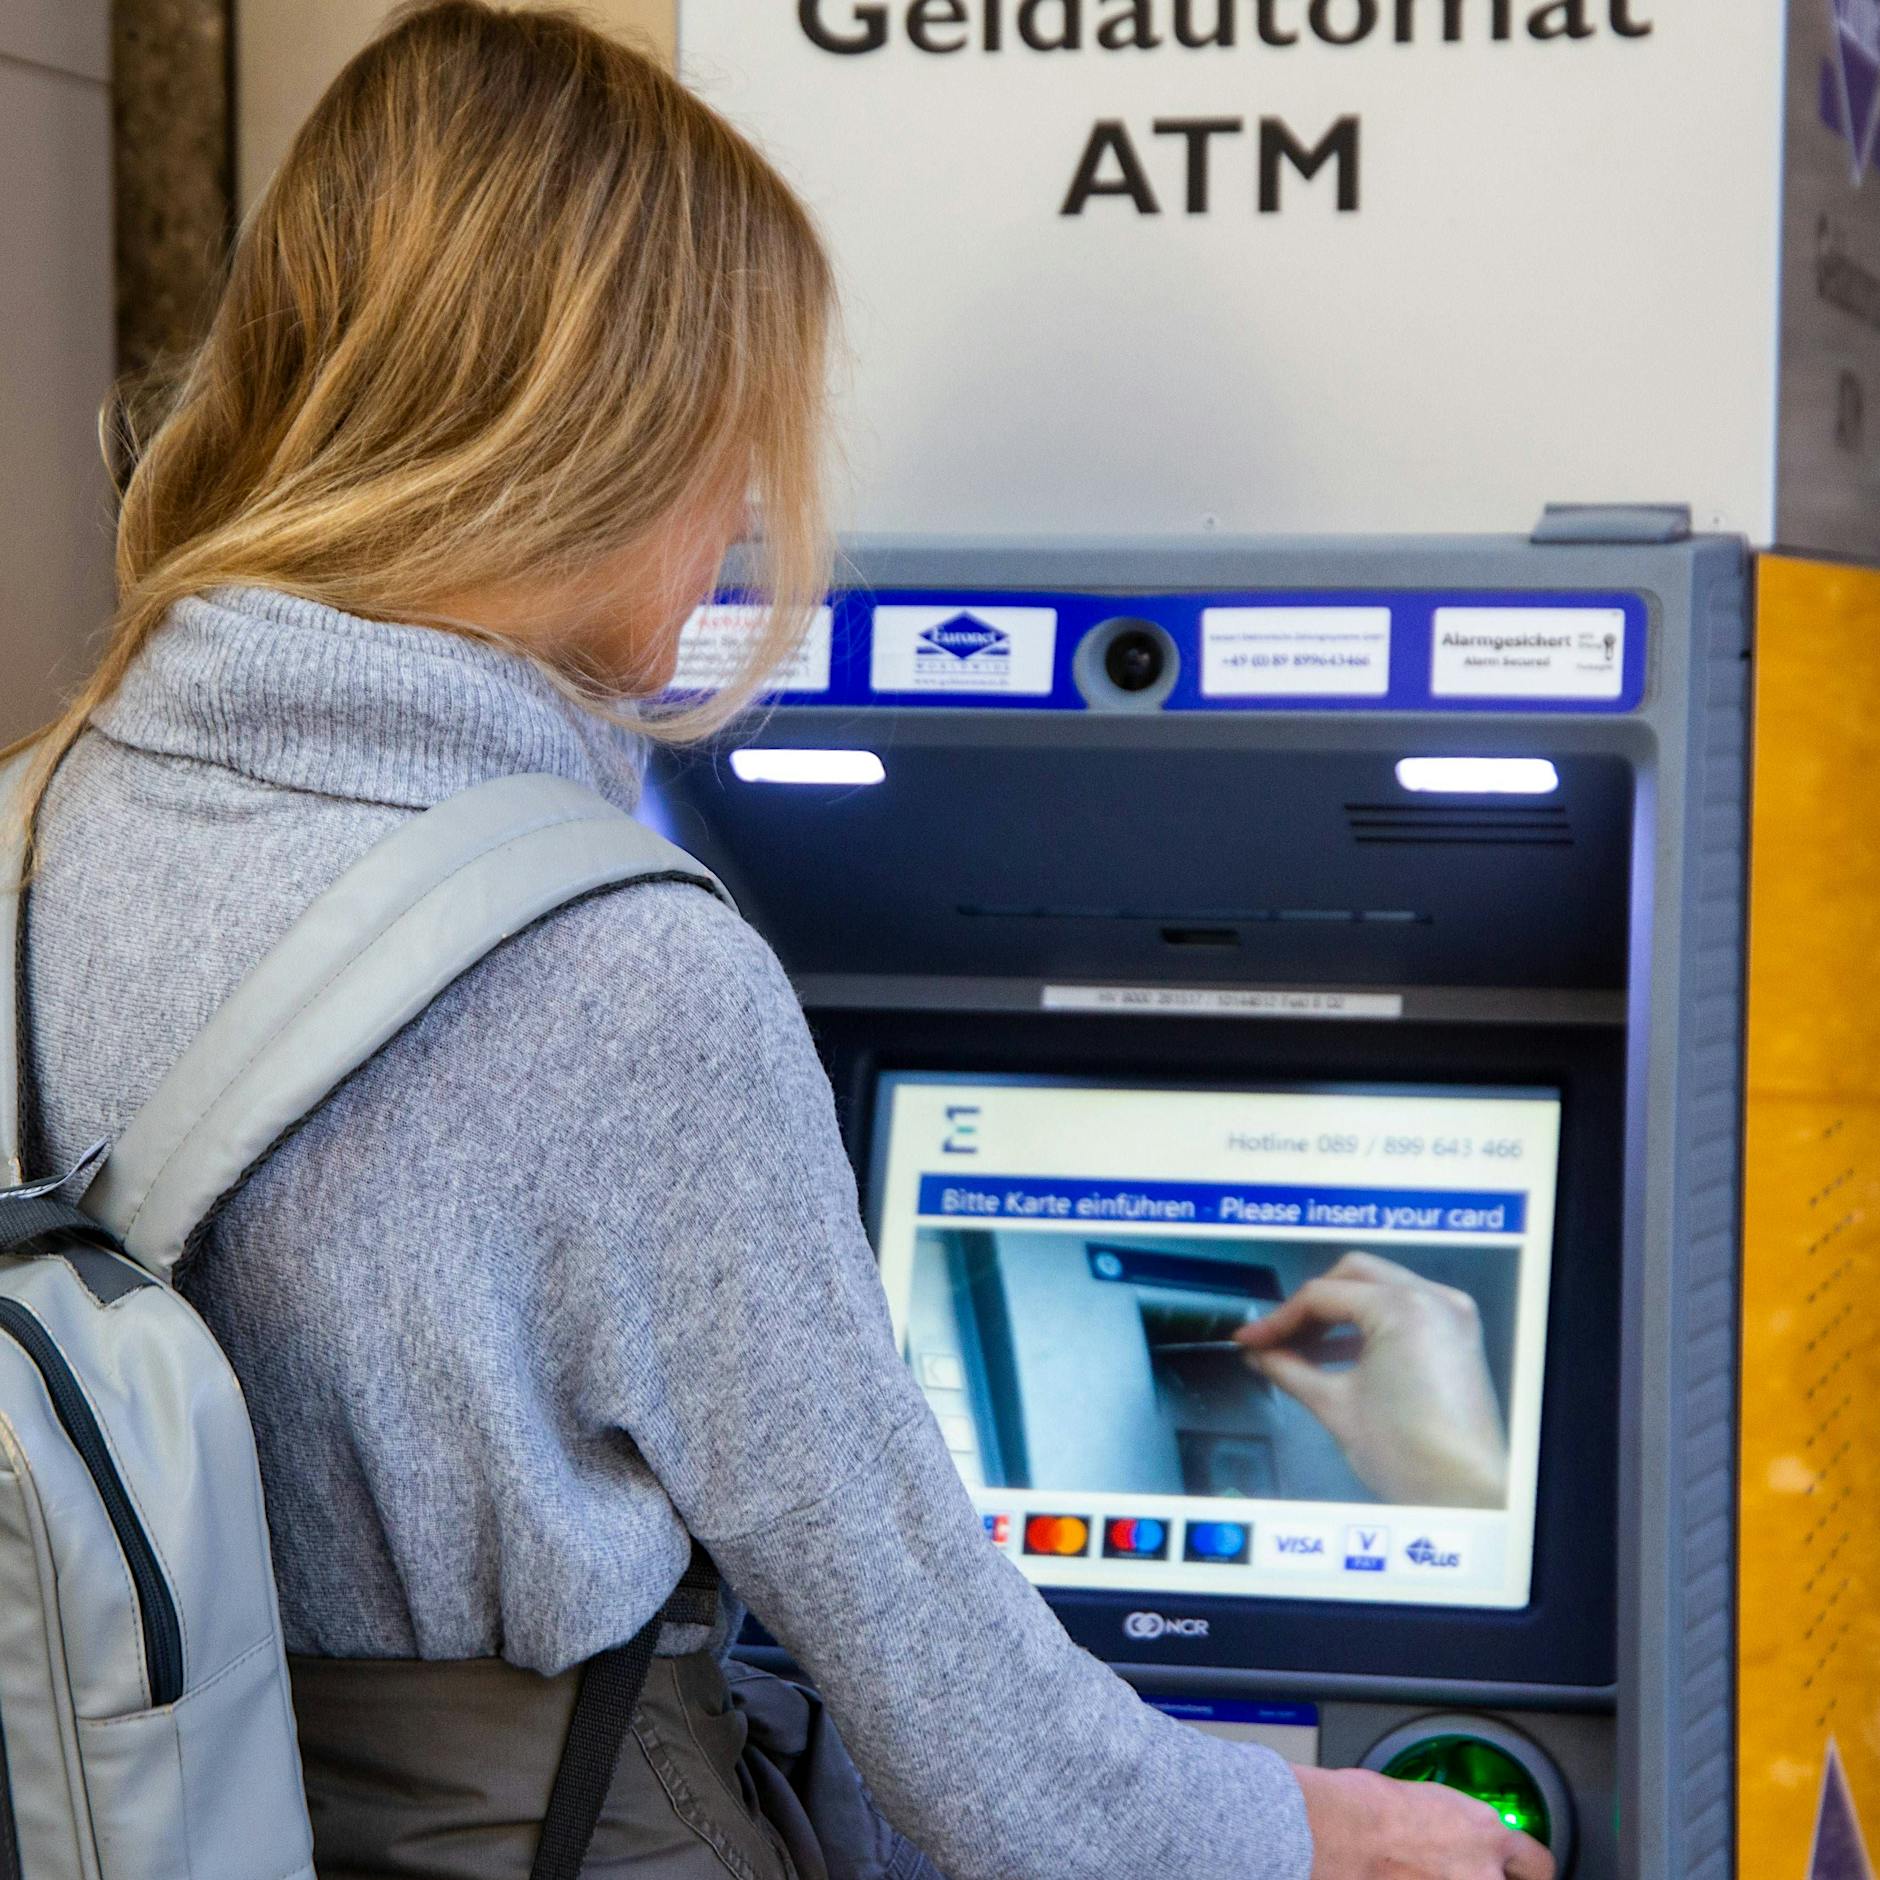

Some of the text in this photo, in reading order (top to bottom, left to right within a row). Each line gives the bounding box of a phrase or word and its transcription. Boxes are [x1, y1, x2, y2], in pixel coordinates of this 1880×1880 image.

[1059, 114, 1361, 215] ATM
[931, 626, 996, 645] Euronet
[1442, 632, 1572, 649] Alarmgesichert
[1464, 656, 1551, 669] Alarm Secured
[1227, 1132, 1309, 1154] Hotline
[1482, 1139, 1522, 1158] 466
[942, 1188, 999, 1213] Bitte
[1005, 1191, 1071, 1214] Karte
[1077, 1192, 1196, 1219] einführen
[1220, 1197, 1302, 1222] Please
[1307, 1201, 1379, 1224] insert
[1384, 1208, 1447, 1233] your
[1449, 1205, 1504, 1229] card
[1275, 1536, 1325, 1554] VISA
[1165, 1619, 1209, 1636] NCR
